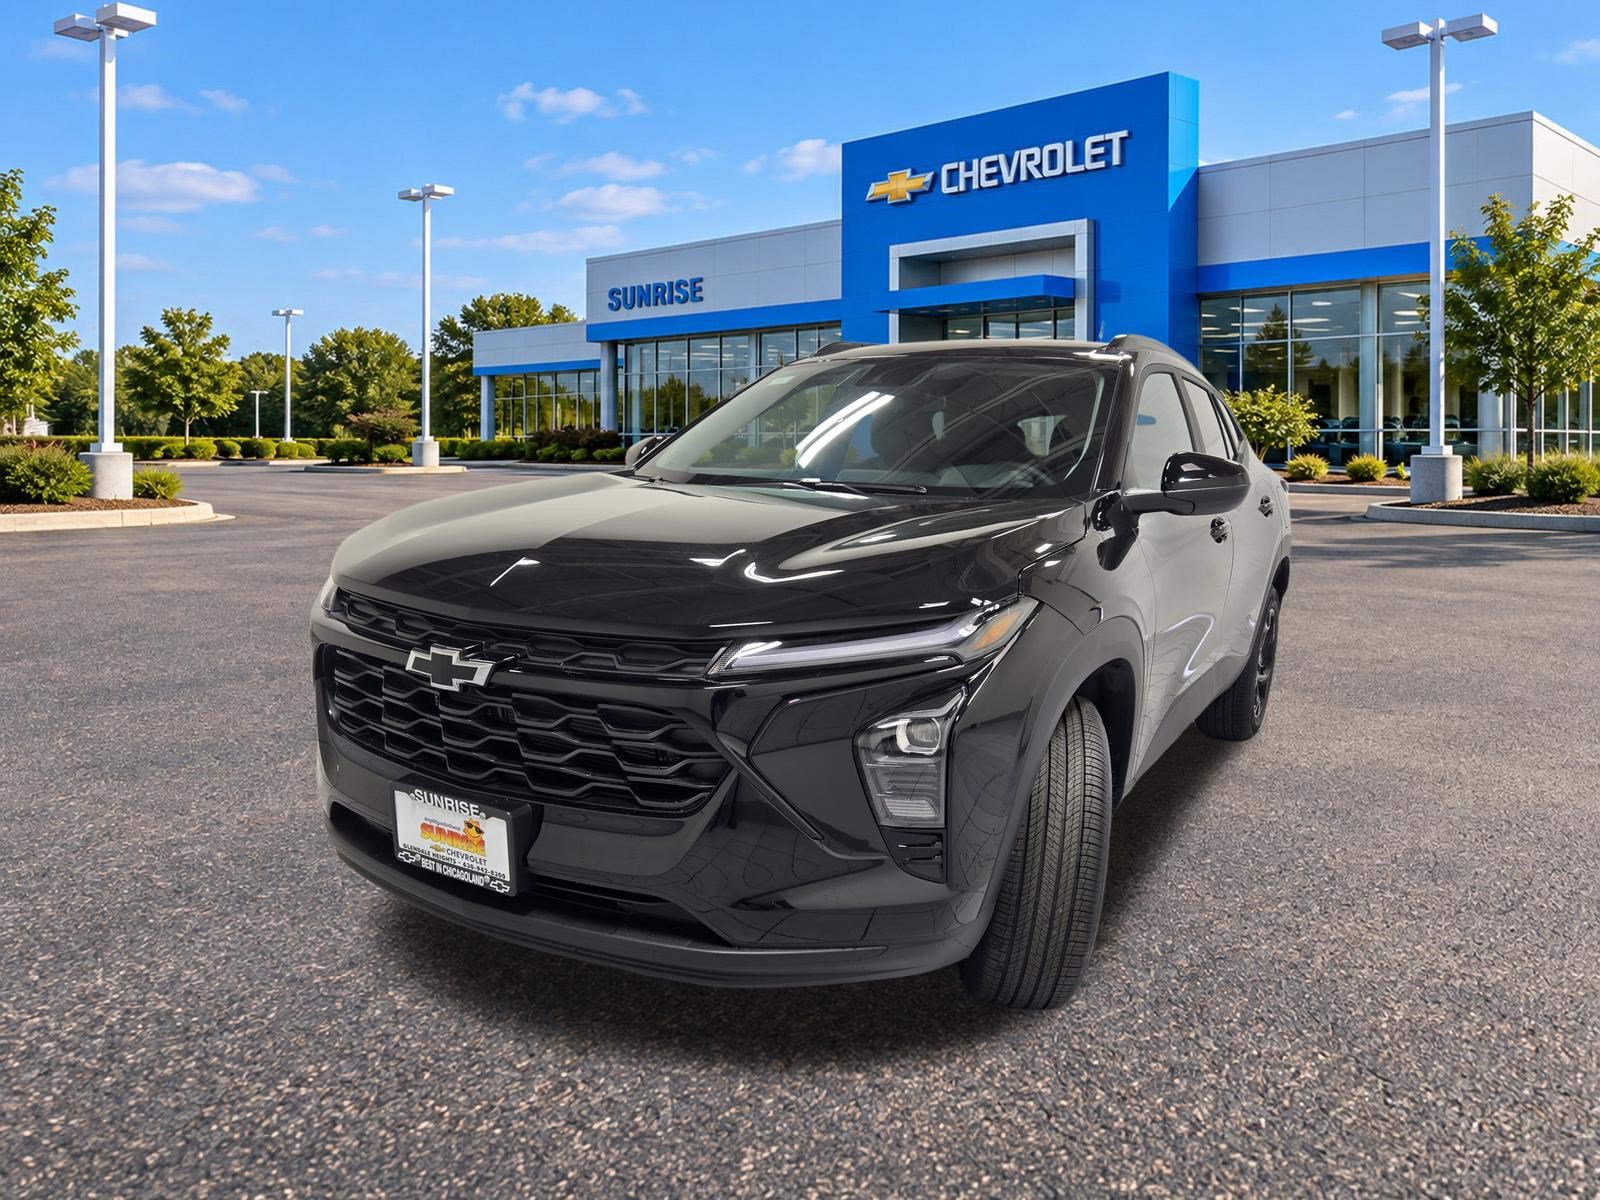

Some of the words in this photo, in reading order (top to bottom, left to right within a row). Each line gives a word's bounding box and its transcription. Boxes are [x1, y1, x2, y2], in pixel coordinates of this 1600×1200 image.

[941, 130, 1129, 195] CHEVROLET
[607, 277, 704, 312] SUNRISE
[414, 789, 480, 817] SUNRISE
[402, 843, 431, 857] GLENDALE
[432, 851, 457, 864] HEIGHTS
[446, 848, 487, 866] CHEVROLET
[421, 858, 436, 872] BEST
[436, 862, 443, 874] IN
[443, 864, 484, 886] CHICAGOLAND
